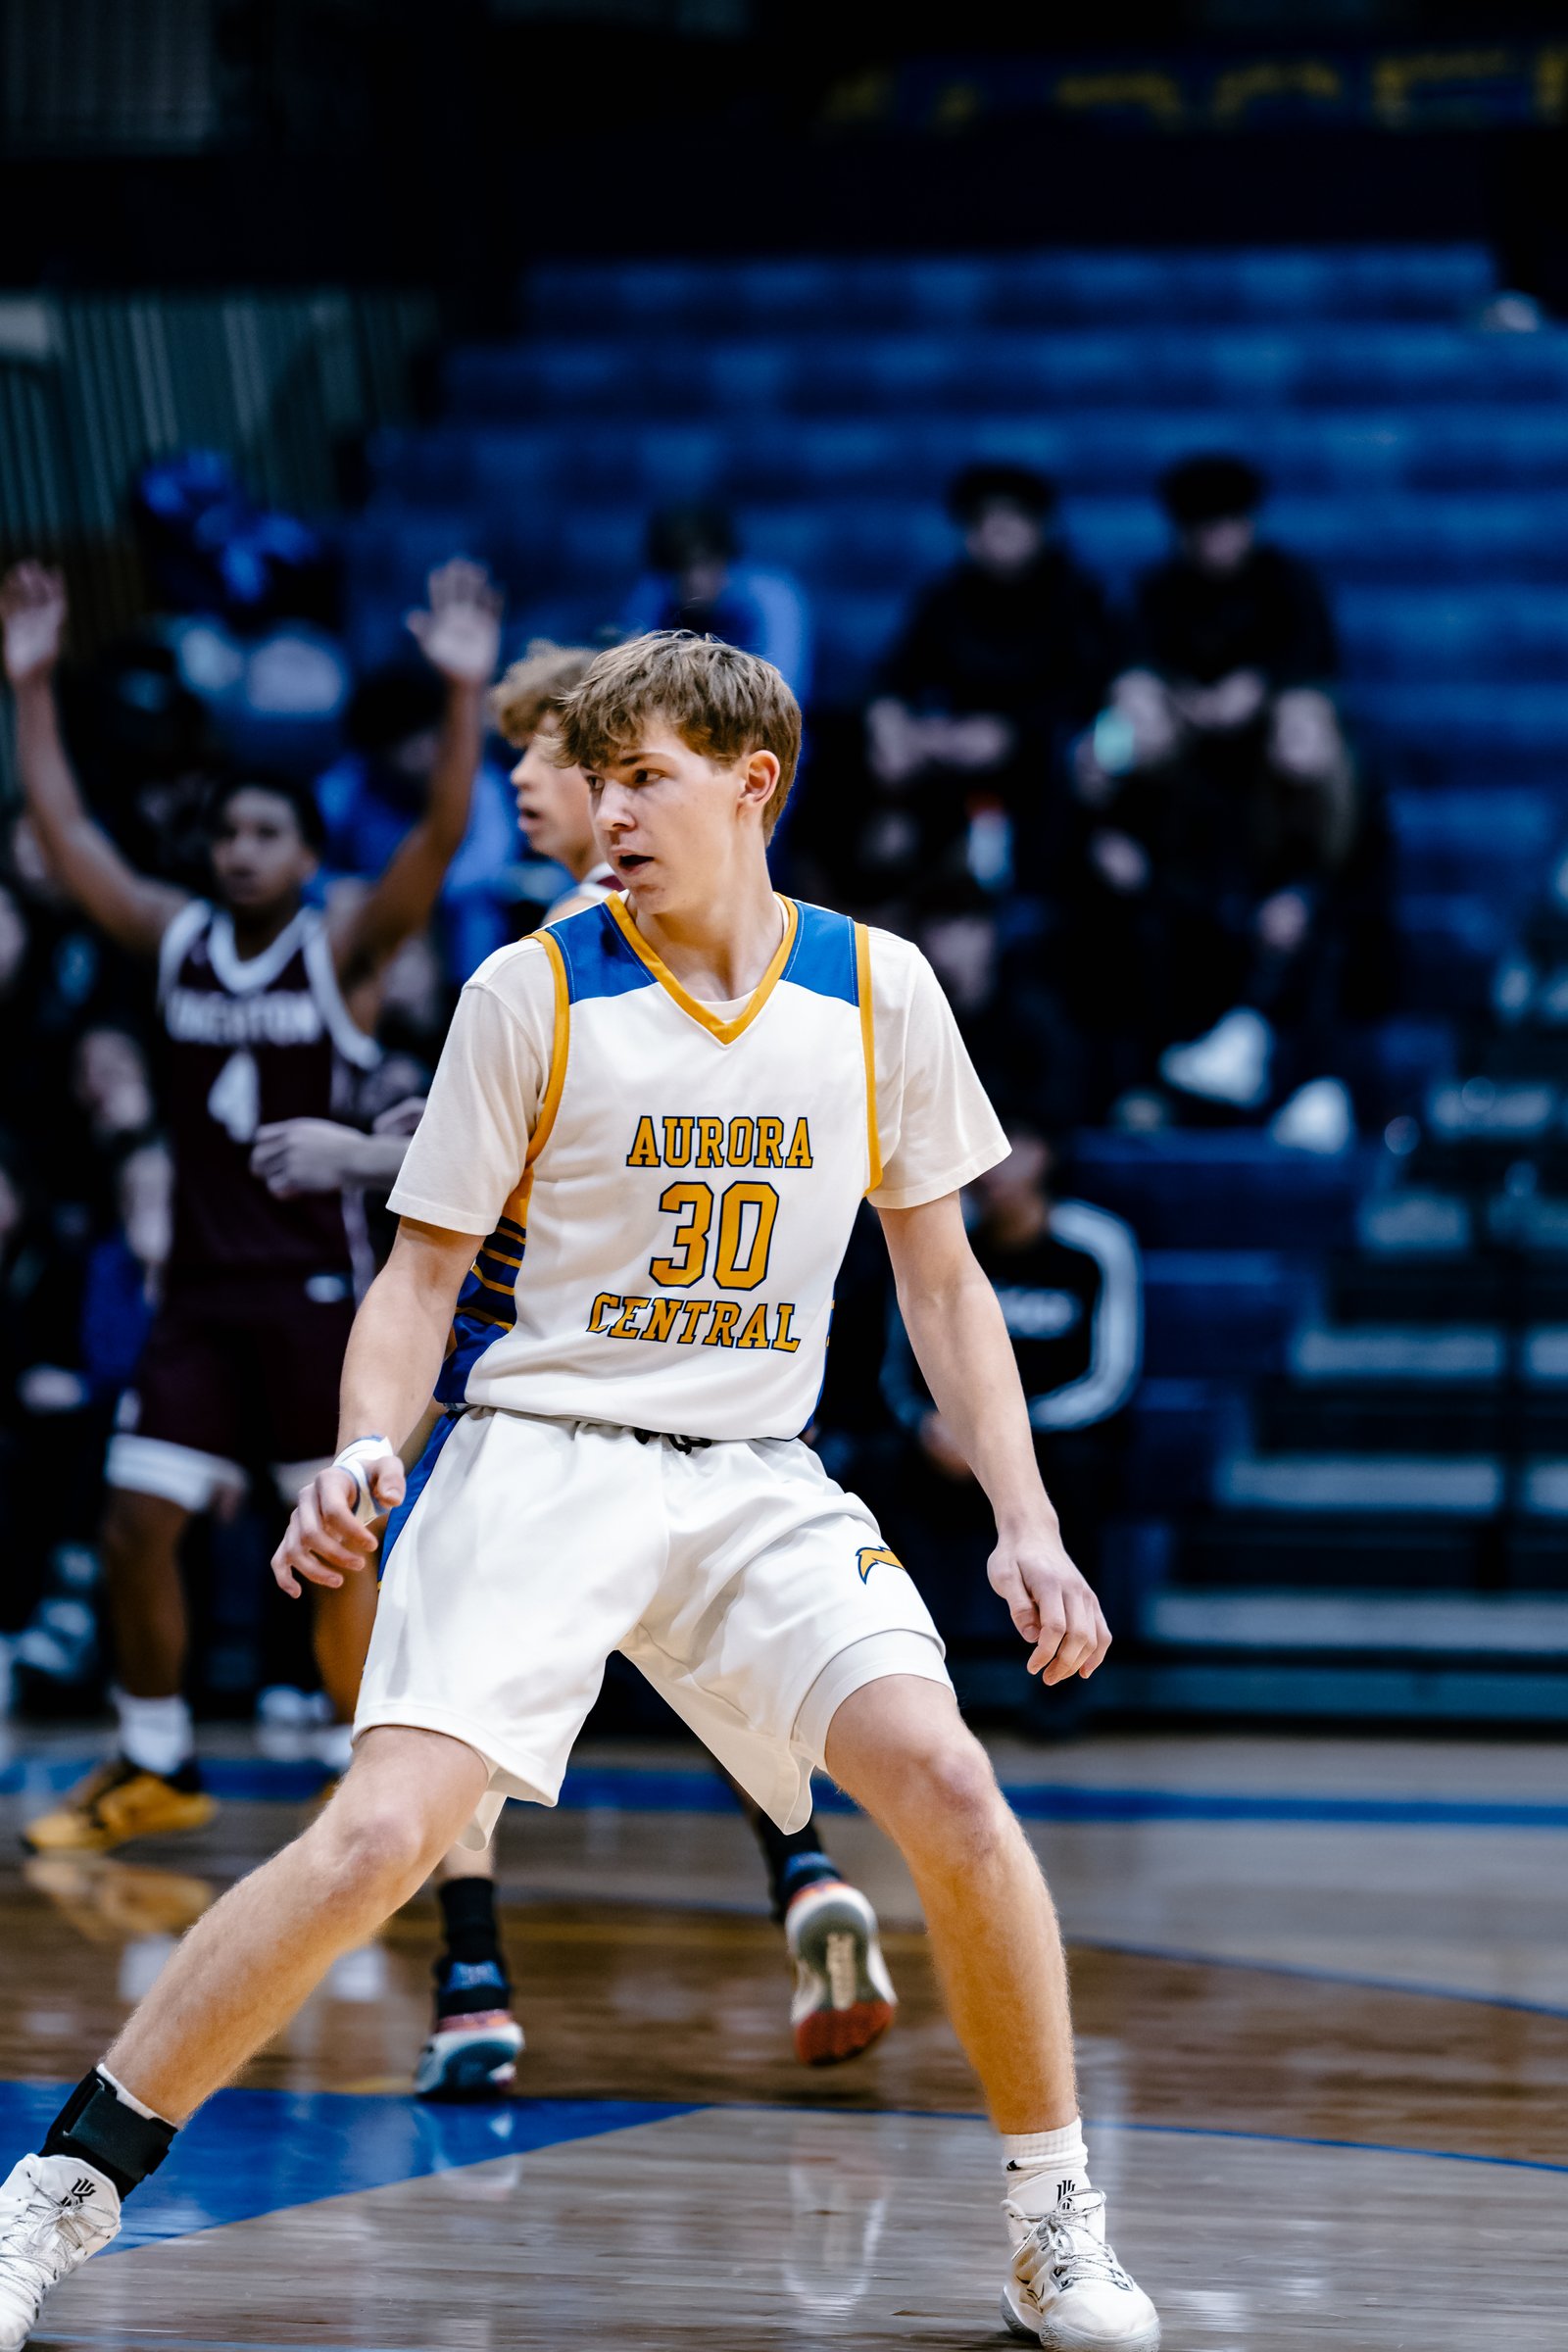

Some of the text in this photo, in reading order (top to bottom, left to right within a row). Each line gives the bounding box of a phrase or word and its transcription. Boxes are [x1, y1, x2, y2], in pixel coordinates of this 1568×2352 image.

[626, 1115, 813, 1168] AURORA
[649, 1181, 780, 1291] 30
[586, 1292, 801, 1352] CENTRAL
